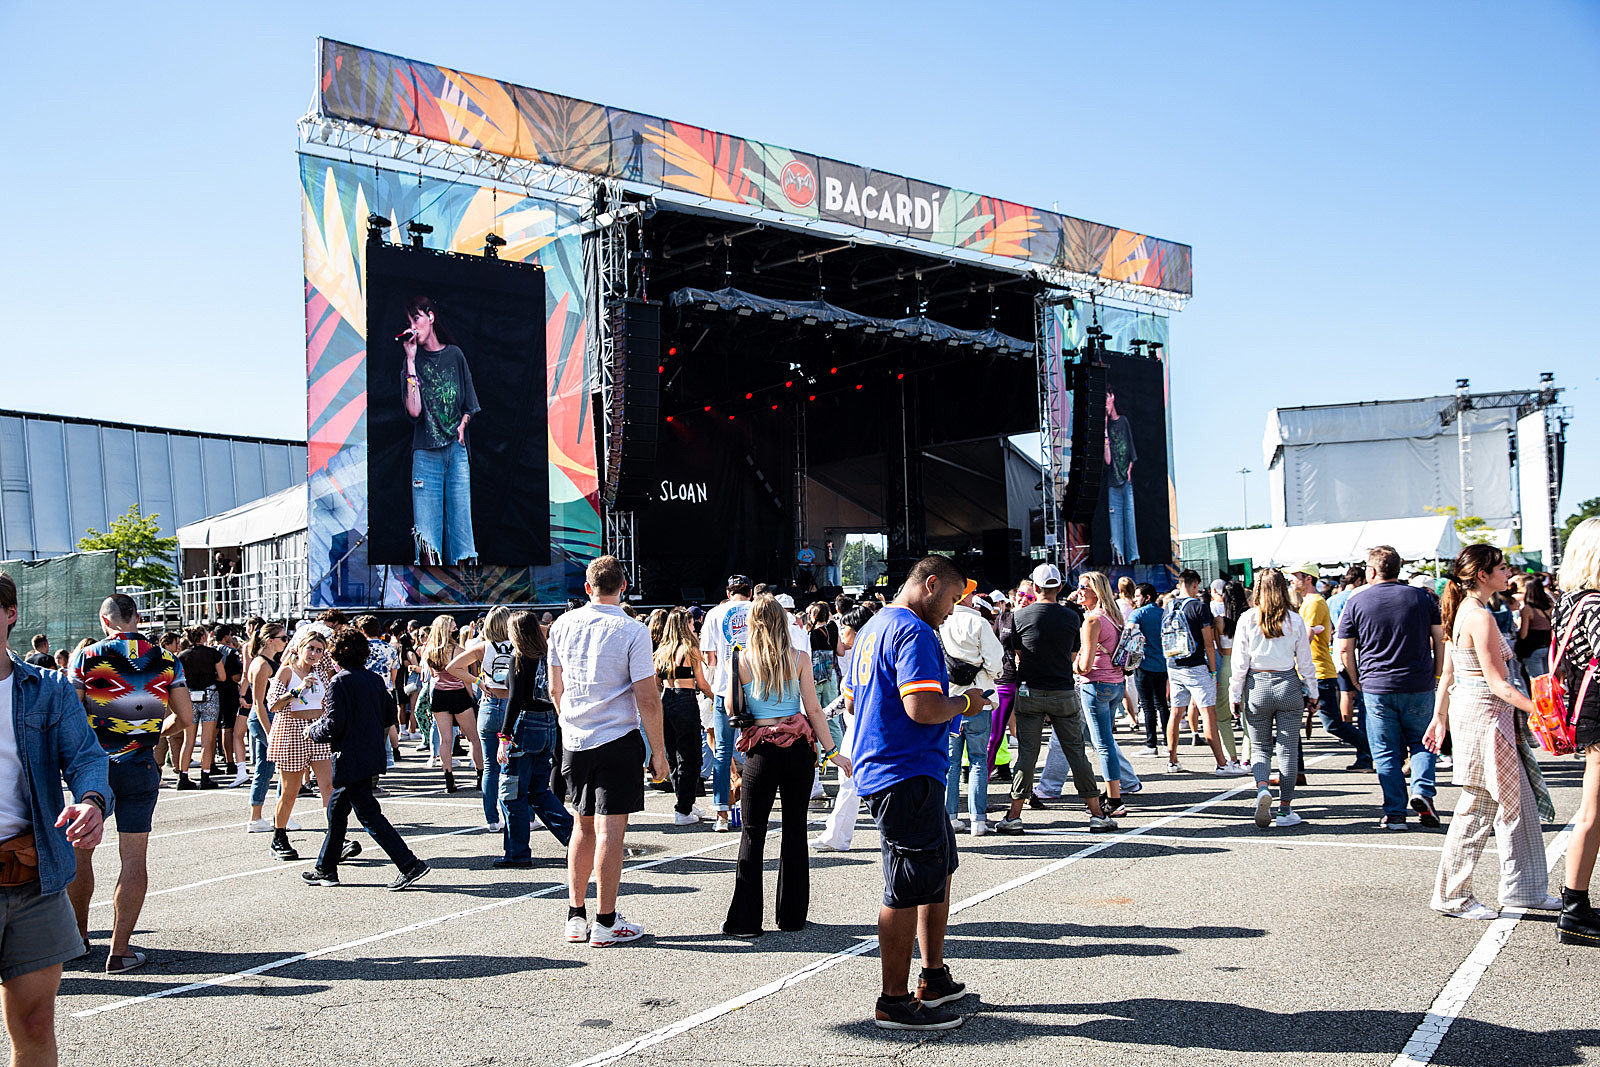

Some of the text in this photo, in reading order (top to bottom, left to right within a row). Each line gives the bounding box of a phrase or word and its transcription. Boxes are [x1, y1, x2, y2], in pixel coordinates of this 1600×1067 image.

[825, 176, 940, 232] BACARDÍ
[660, 480, 708, 503] SLOAN
[852, 632, 877, 686] 18
